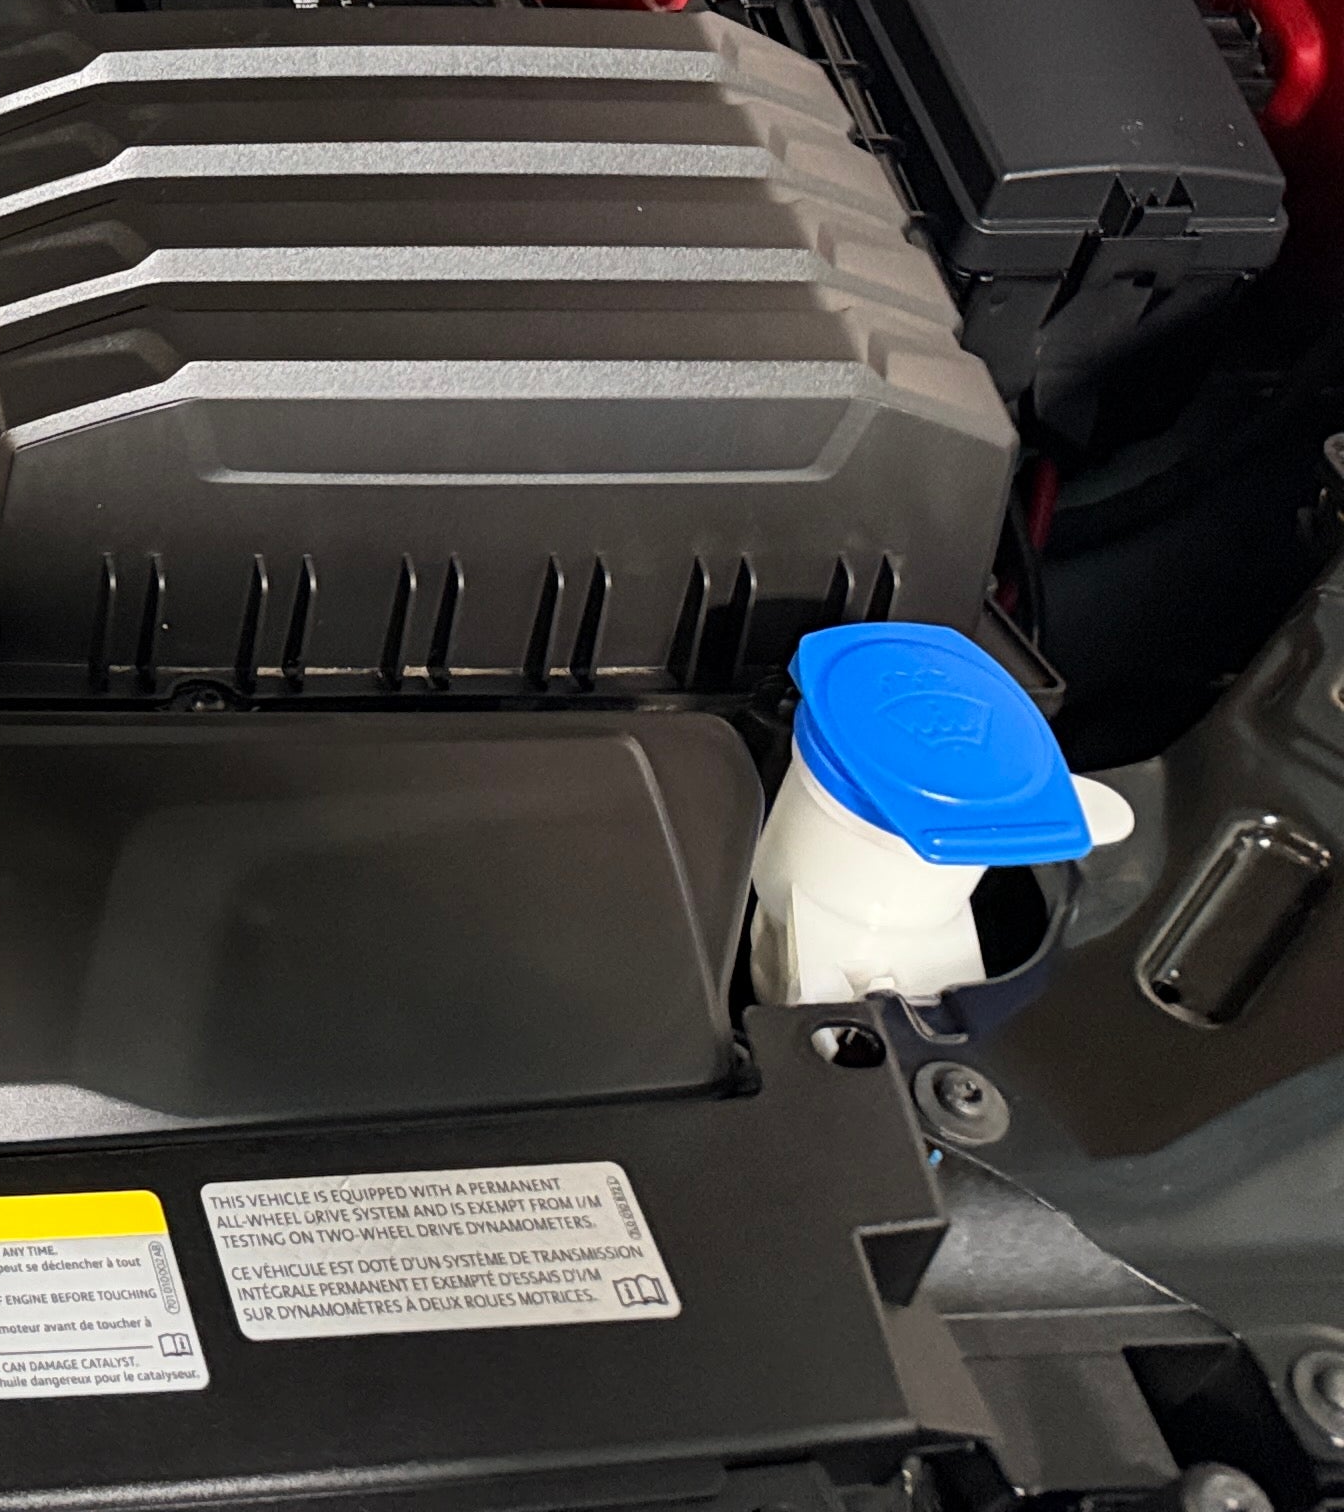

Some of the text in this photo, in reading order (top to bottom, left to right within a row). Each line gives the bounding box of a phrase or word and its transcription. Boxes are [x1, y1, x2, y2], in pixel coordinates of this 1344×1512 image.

[208, 1177, 560, 1209] THIS VEHICLE IS EQUIPPED WITH A PERMANENT
[216, 1211, 302, 1228] ALL-WHEEL
[303, 1208, 350, 1224] DRIVE
[351, 1205, 410, 1221] SYSTEM
[413, 1203, 448, 1217] AND
[449, 1202, 465, 1215] IS
[466, 1199, 525, 1215] EXEMPT
[527, 1196, 574, 1212] FROM
[220, 1231, 286, 1248] TESTING
[288, 1230, 314, 1244] ON
[315, 1225, 415, 1242] TWO-WHEEL
[415, 1222, 464, 1237] DRIVE
[2, 1246, 24, 1257] ANY
[231, 1245, 644, 1281] CE VÉHICULE EST DOTÉ D'UN SYSTÈME DE TRANSMISSION
[4, 1293, 48, 1305] ENGINE
[50, 1291, 95, 1303] BEFORE
[96, 1288, 157, 1301] TOUCHING
[236, 1283, 318, 1301] INTÉGRALE
[318, 1277, 408, 1296] PERMANENT
[410, 1276, 428, 1291] ET
[430, 1272, 497, 1290] EXEMPTÉ
[497, 1269, 561, 1286] D'ESSAIS
[242, 1305, 276, 1321] SUR
[405, 1297, 418, 1312] À
[417, 1295, 463, 1311] DEUX
[463, 1292, 516, 1308] ROUES
[1, 1361, 26, 1373] CAN
[28, 1359, 79, 1372] DAMAGE
